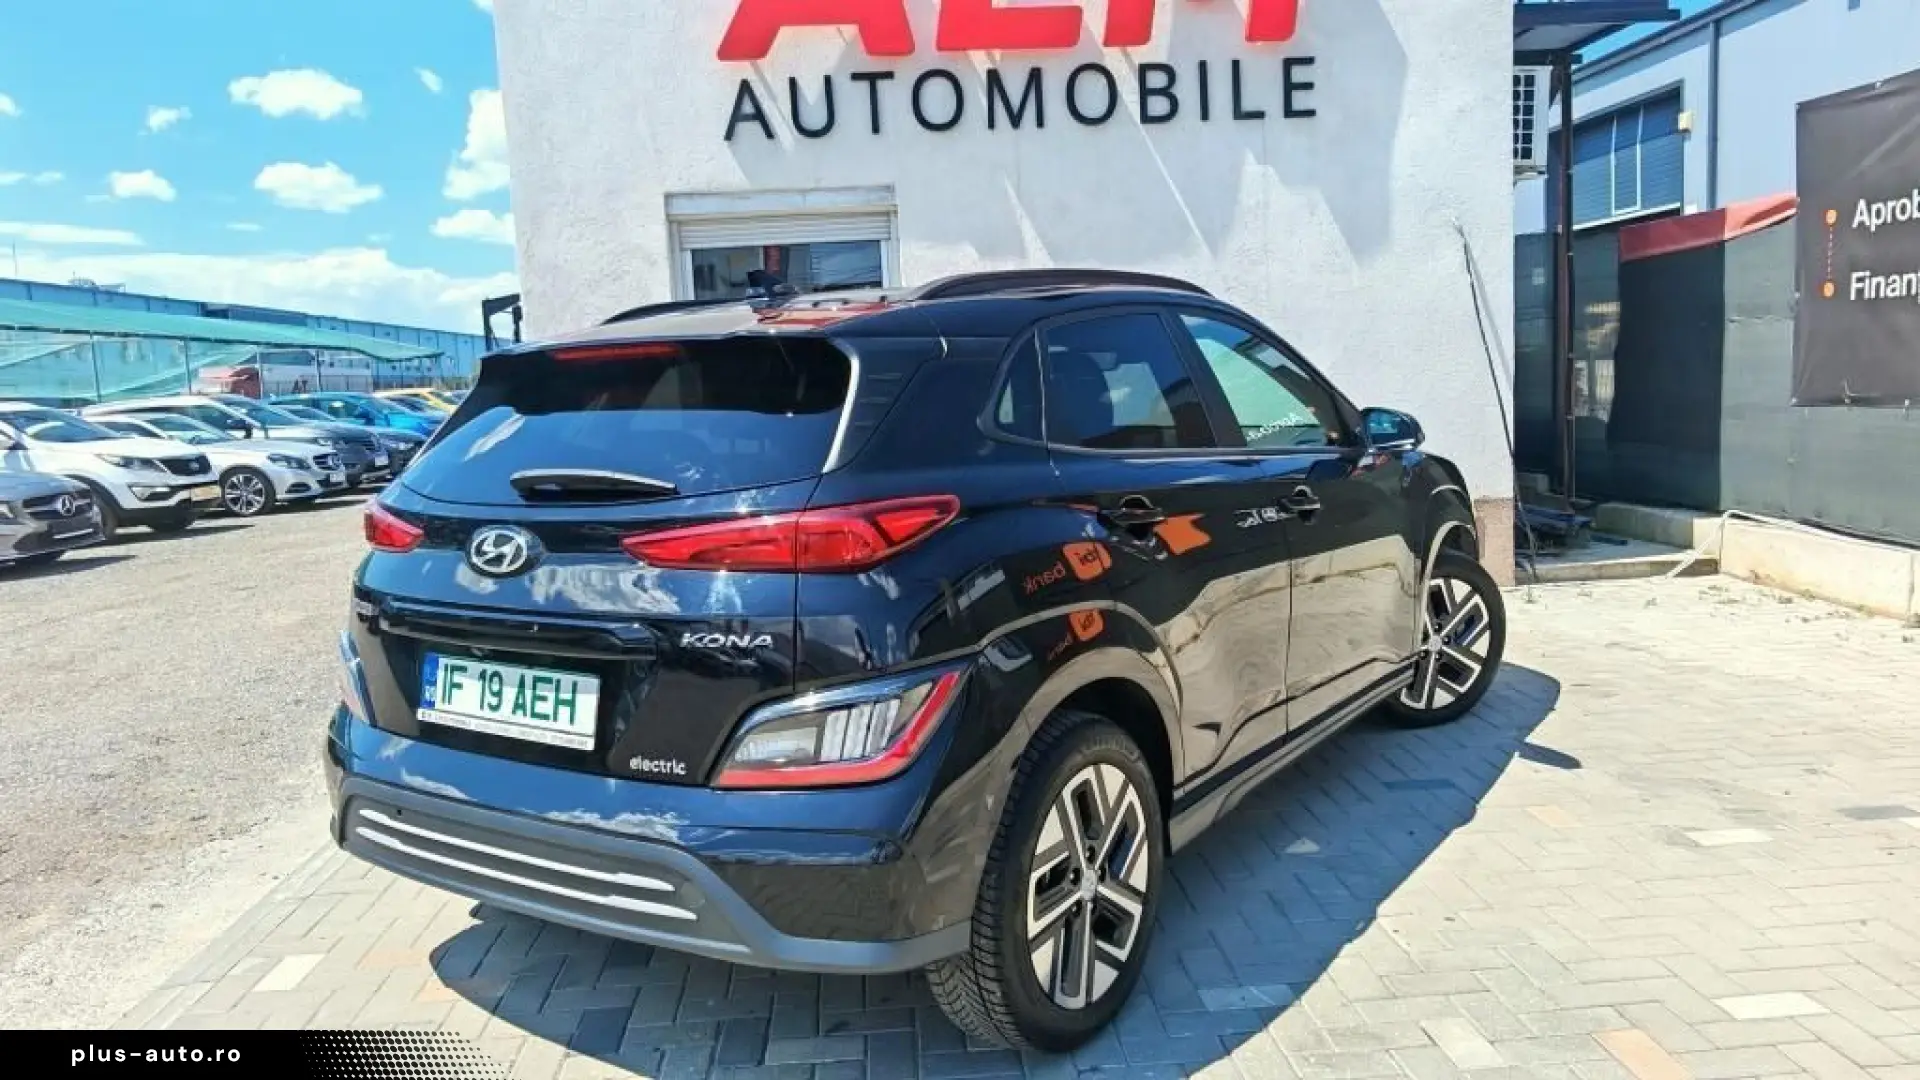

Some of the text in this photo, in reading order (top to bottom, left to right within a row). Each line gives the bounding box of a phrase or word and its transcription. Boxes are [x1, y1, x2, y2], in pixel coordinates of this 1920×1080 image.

[724, 56, 1317, 142] AUTOMOBILE
[679, 633, 774, 649] KONA
[442, 663, 578, 726] IF 19 AEH
[629, 755, 687, 775] electric
